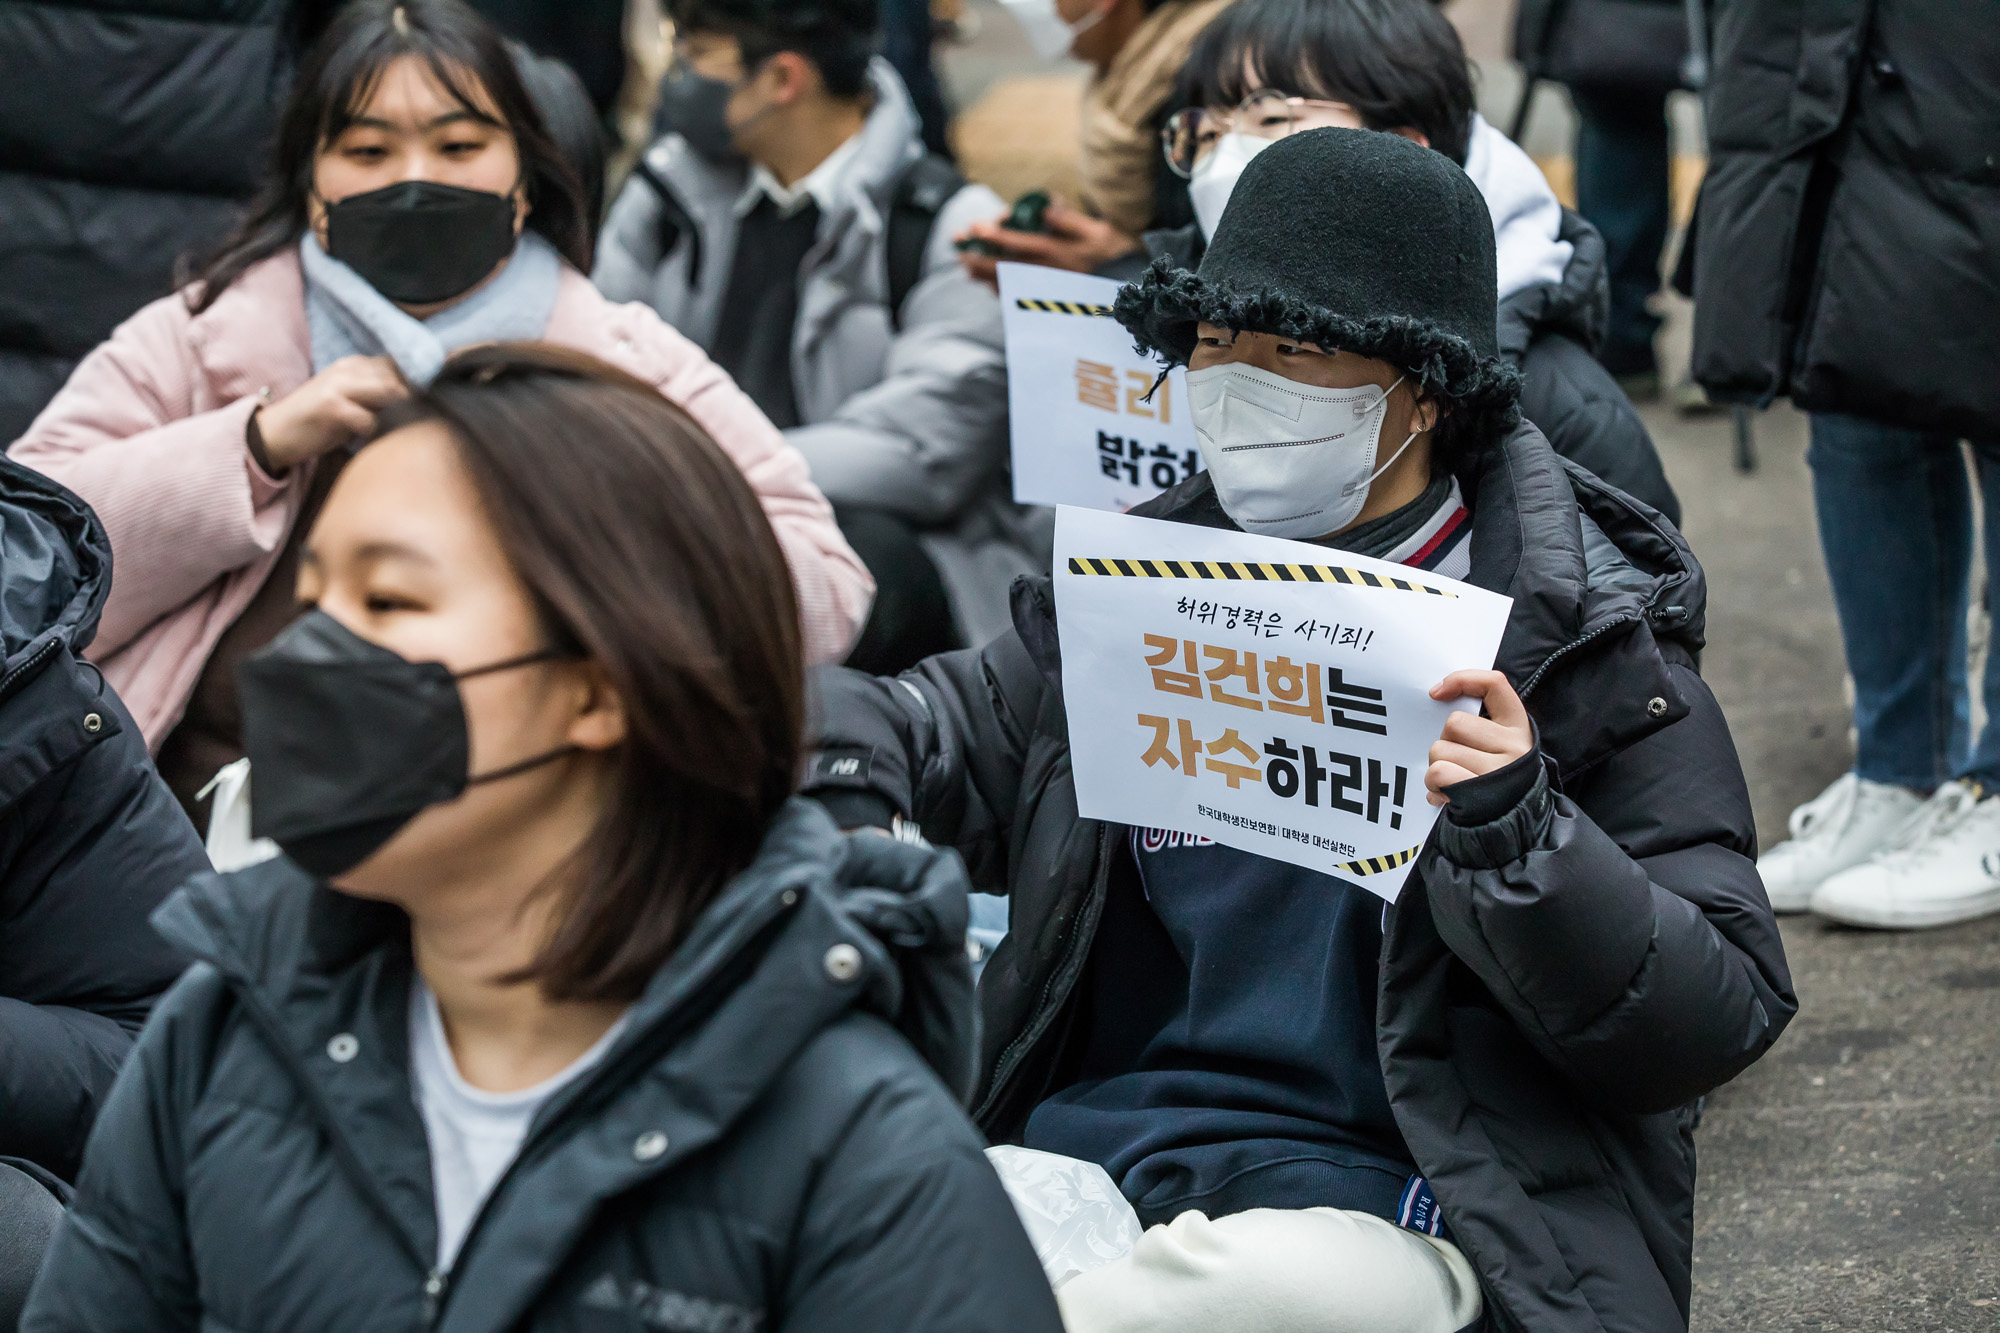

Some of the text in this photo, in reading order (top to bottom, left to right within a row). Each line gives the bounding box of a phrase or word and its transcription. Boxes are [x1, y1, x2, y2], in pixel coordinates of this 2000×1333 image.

[1177, 595, 1375, 652] 허위경력은 사기죄!
[1143, 632, 1388, 737] 김건희는
[1137, 713, 1408, 831] 자수하라!
[1281, 827, 1310, 845] 대학생
[1312, 834, 1357, 858] 대선실천단
